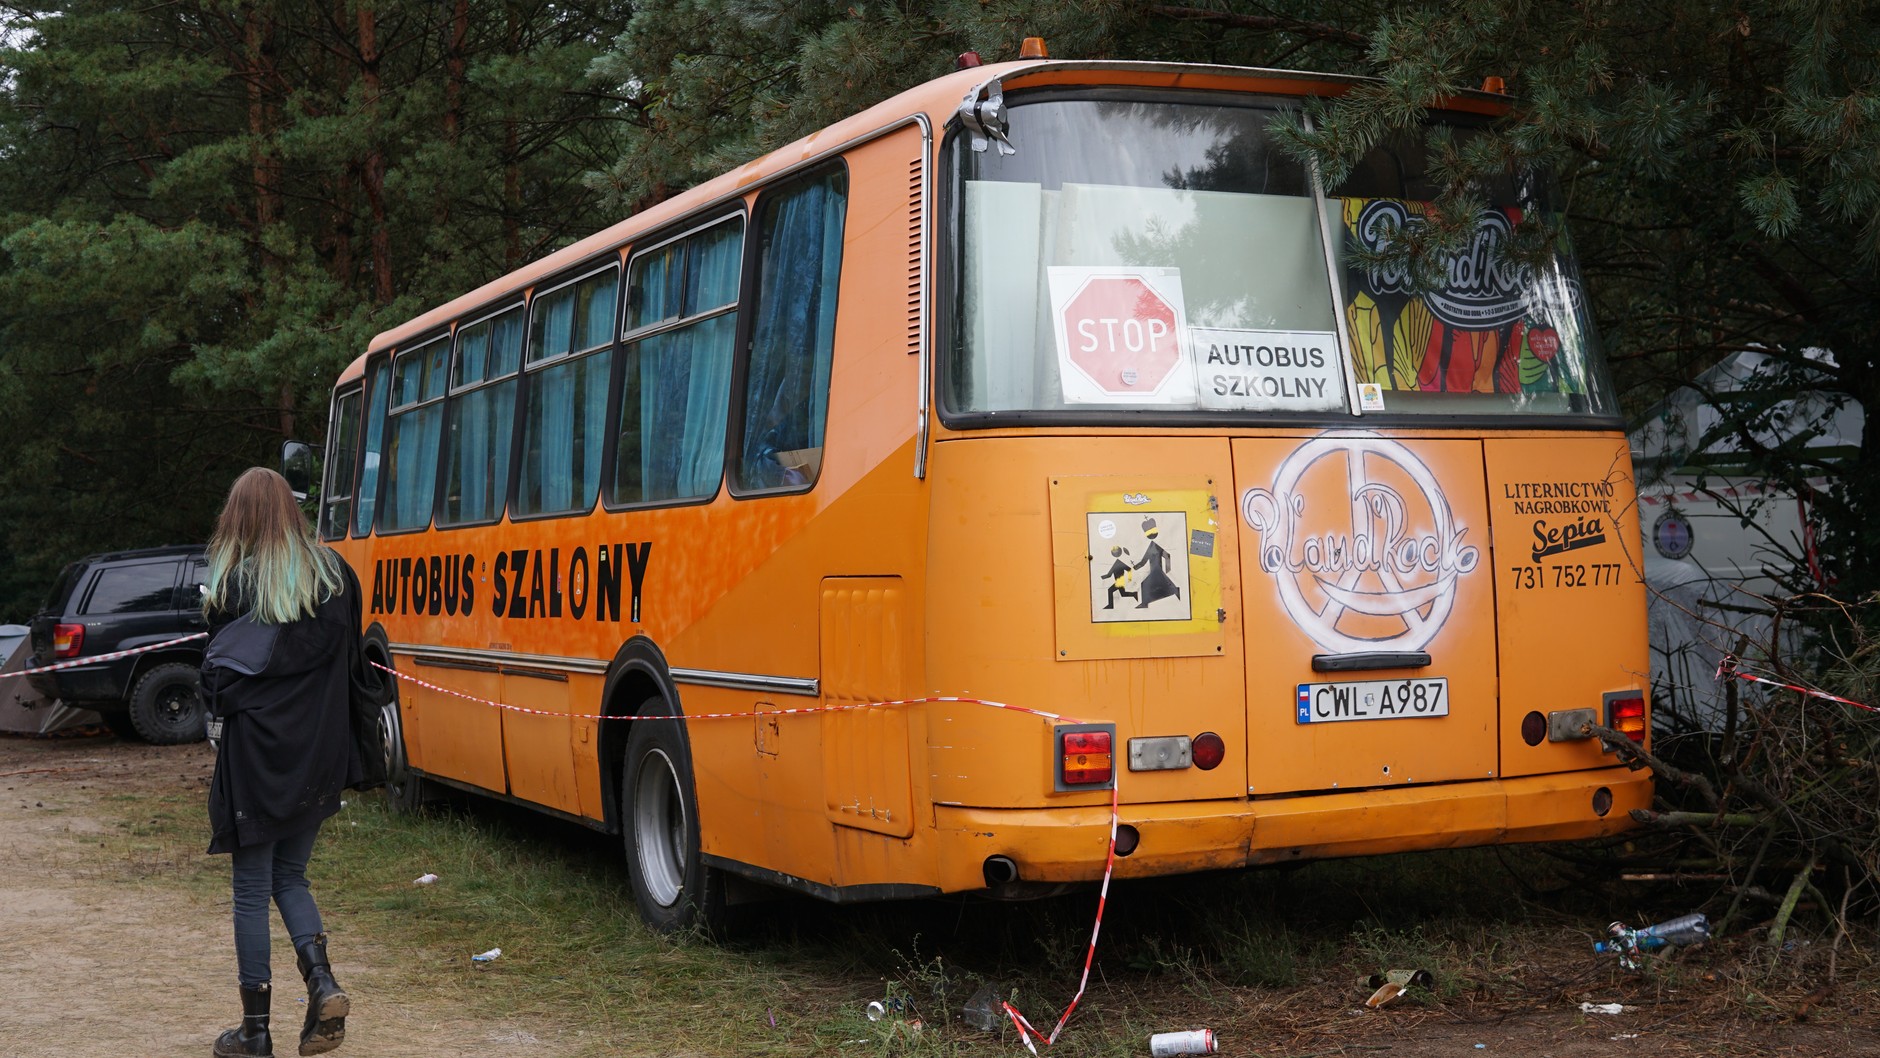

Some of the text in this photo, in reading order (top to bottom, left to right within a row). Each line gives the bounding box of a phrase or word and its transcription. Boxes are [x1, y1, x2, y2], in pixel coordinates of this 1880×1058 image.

[1077, 318, 1168, 353] STOP
[1208, 344, 1325, 368] AUTOBUS
[1213, 374, 1327, 398] SZKOLNY
[1504, 482, 1614, 499] LITERNICTWO
[1514, 500, 1611, 515] NAGROBKOWE
[1532, 516, 1604, 552] Sepia
[370, 542, 652, 623] AUTOBUS SZALONY
[1512, 564, 1621, 589] 731 752 777
[1299, 682, 1443, 718] PL CWL A987
